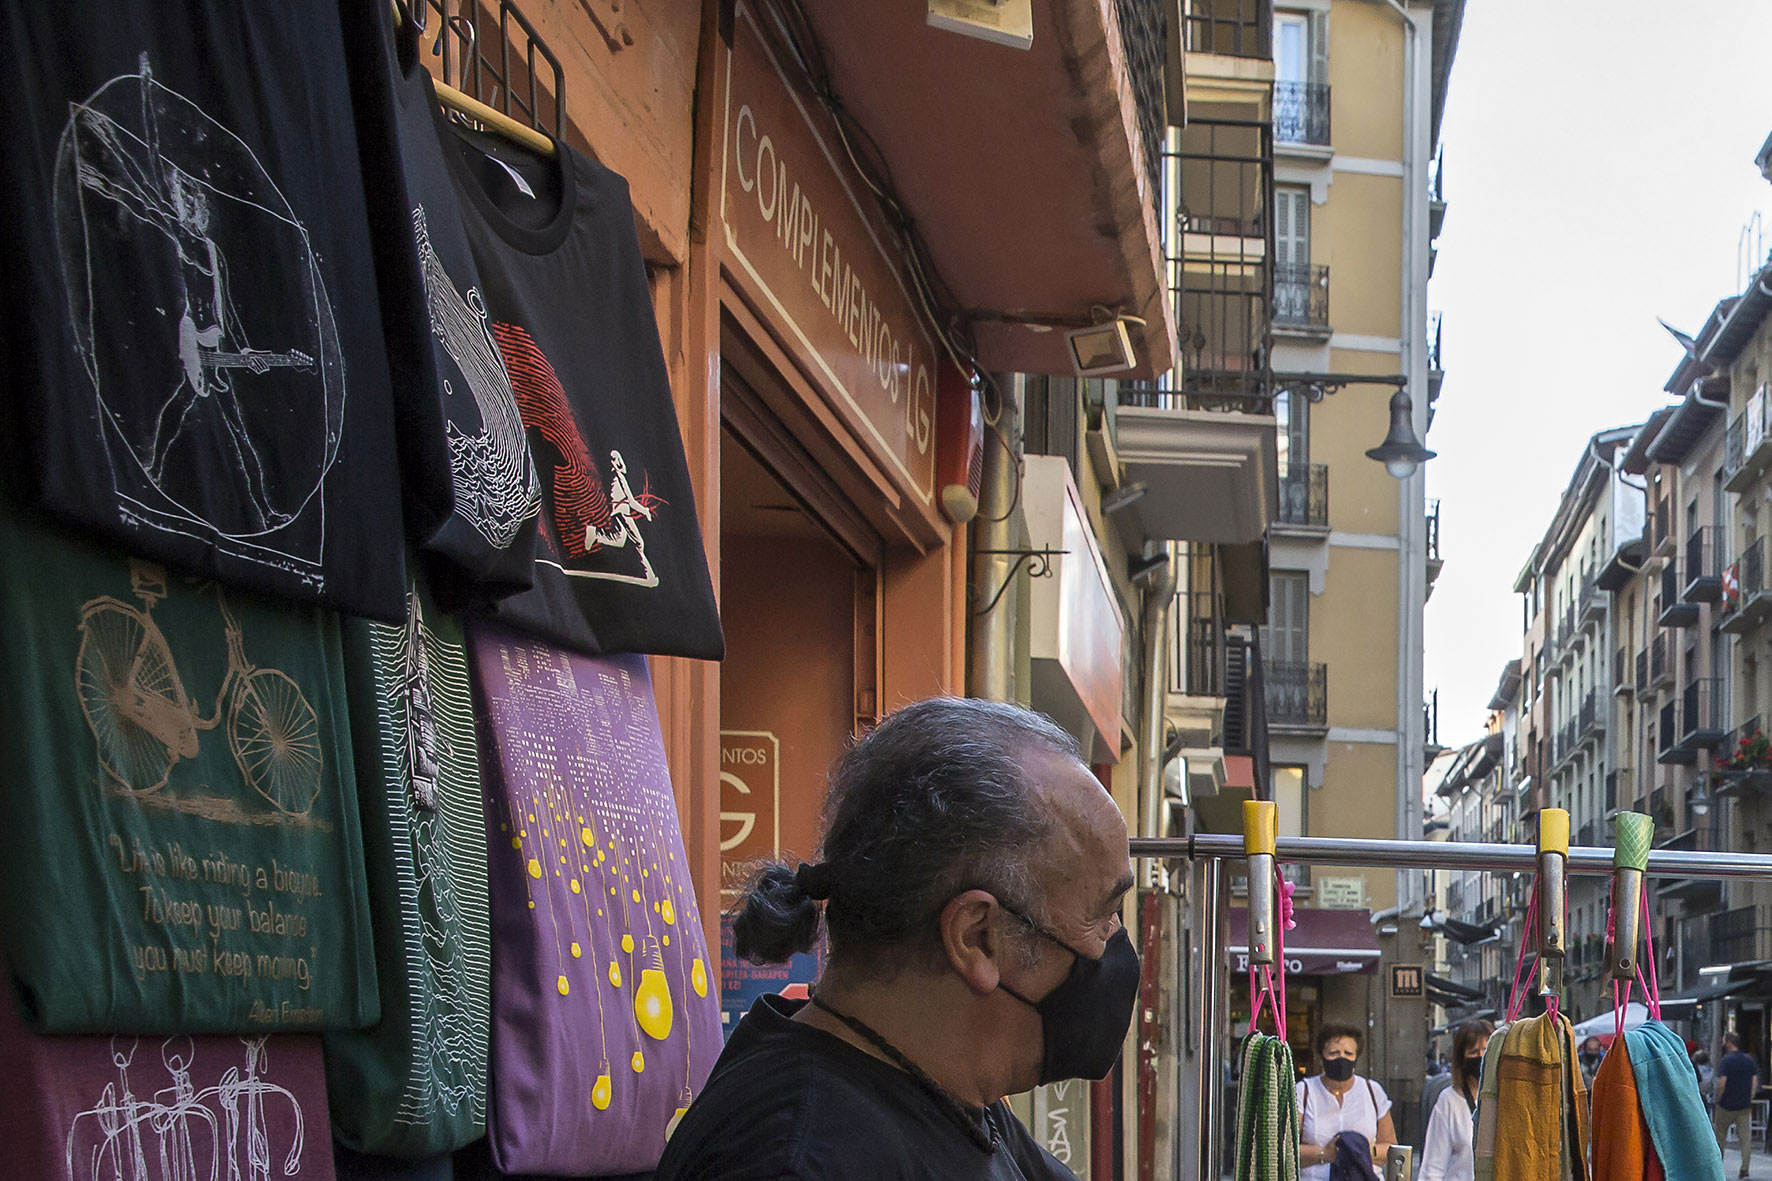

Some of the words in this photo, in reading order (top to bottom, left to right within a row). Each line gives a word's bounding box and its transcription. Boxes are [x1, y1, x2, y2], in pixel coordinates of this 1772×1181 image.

[735, 104, 900, 405] COMPLEMENTOS
[906, 343, 930, 455] LG
[167, 840, 198, 881] like
[202, 851, 251, 897] riding
[255, 867, 268, 889] a
[208, 903, 243, 938] your
[133, 945, 167, 981] you
